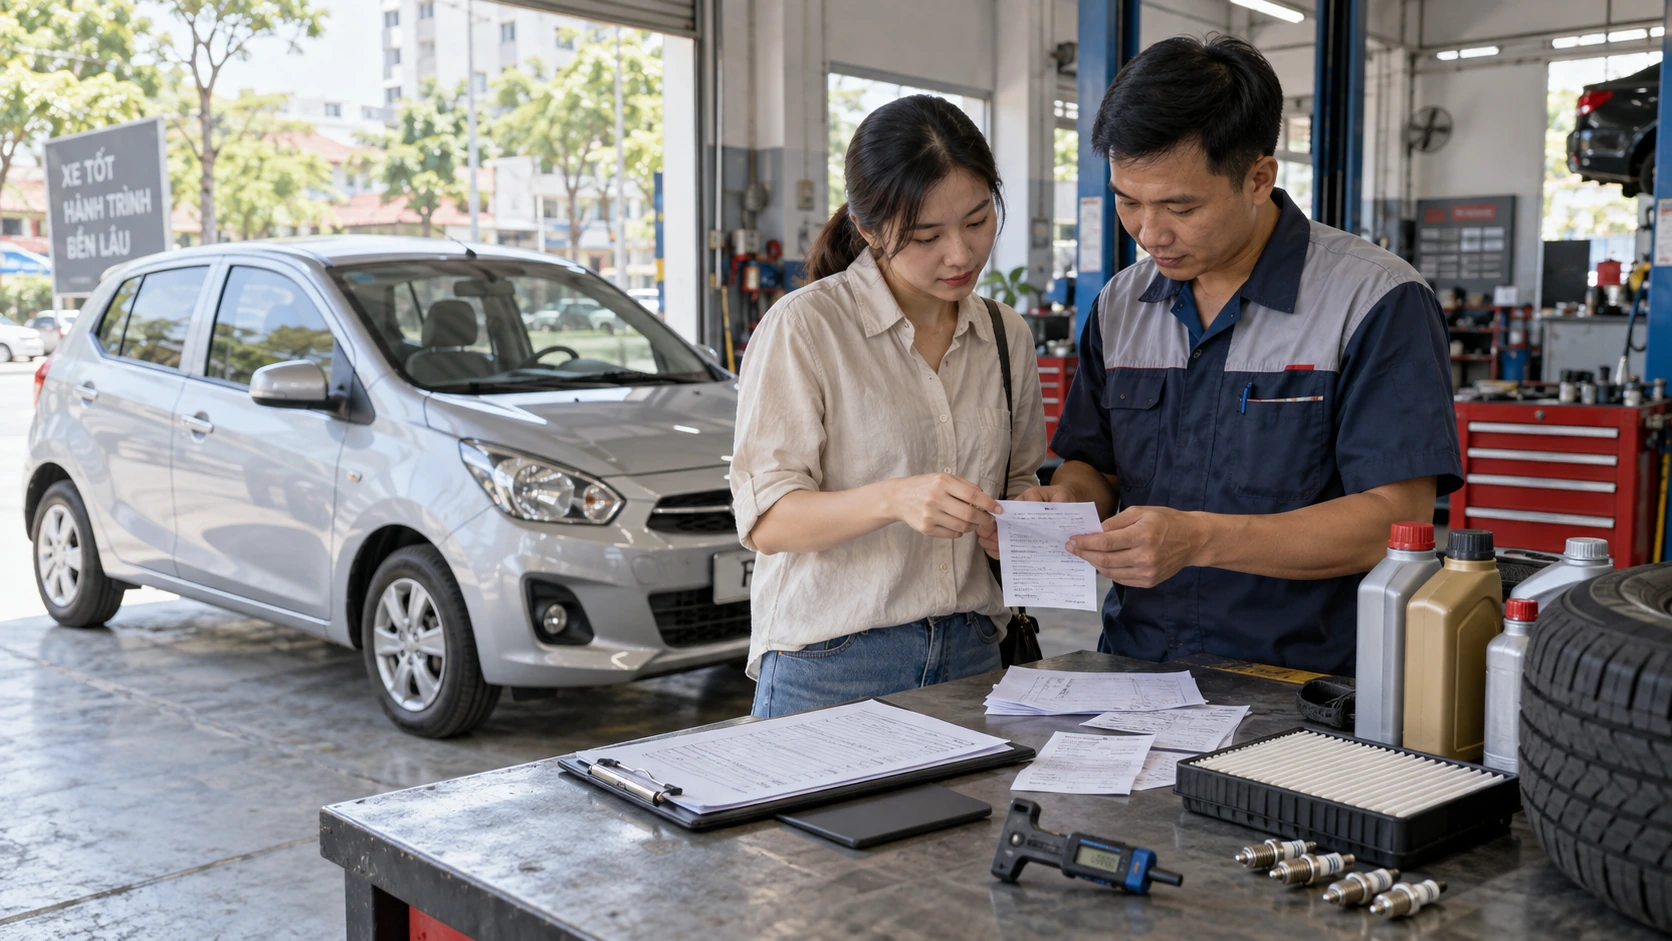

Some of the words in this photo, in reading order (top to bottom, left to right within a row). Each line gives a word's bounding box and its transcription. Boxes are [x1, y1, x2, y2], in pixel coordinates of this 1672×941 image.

[61, 162, 82, 188] XE
[83, 147, 115, 184] TỐT
[106, 185, 152, 218] TRÌNH
[99, 224, 131, 257] LÂU
